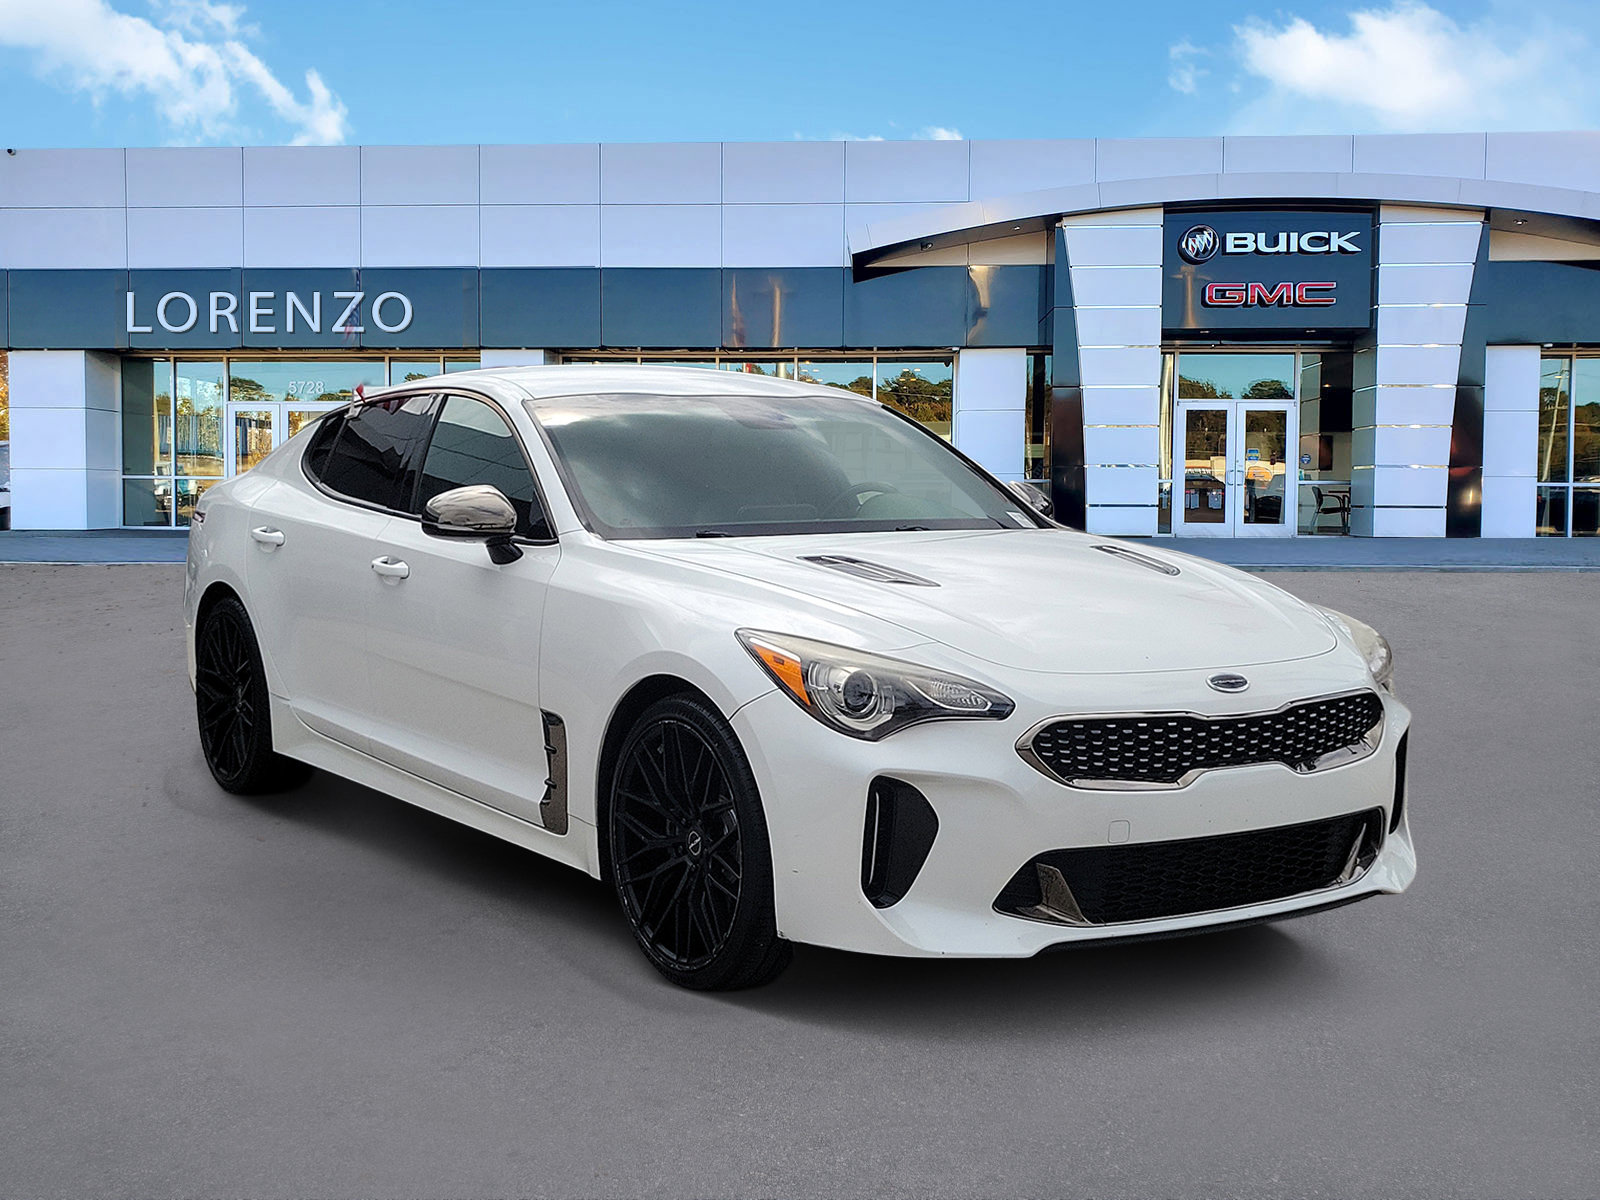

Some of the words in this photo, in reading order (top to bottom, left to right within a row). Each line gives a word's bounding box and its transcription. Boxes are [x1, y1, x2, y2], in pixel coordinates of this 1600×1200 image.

[1225, 231, 1361, 253] BUICK
[1205, 281, 1337, 305] GMC
[126, 291, 414, 333] LORENZO
[288, 380, 325, 394] 5728
